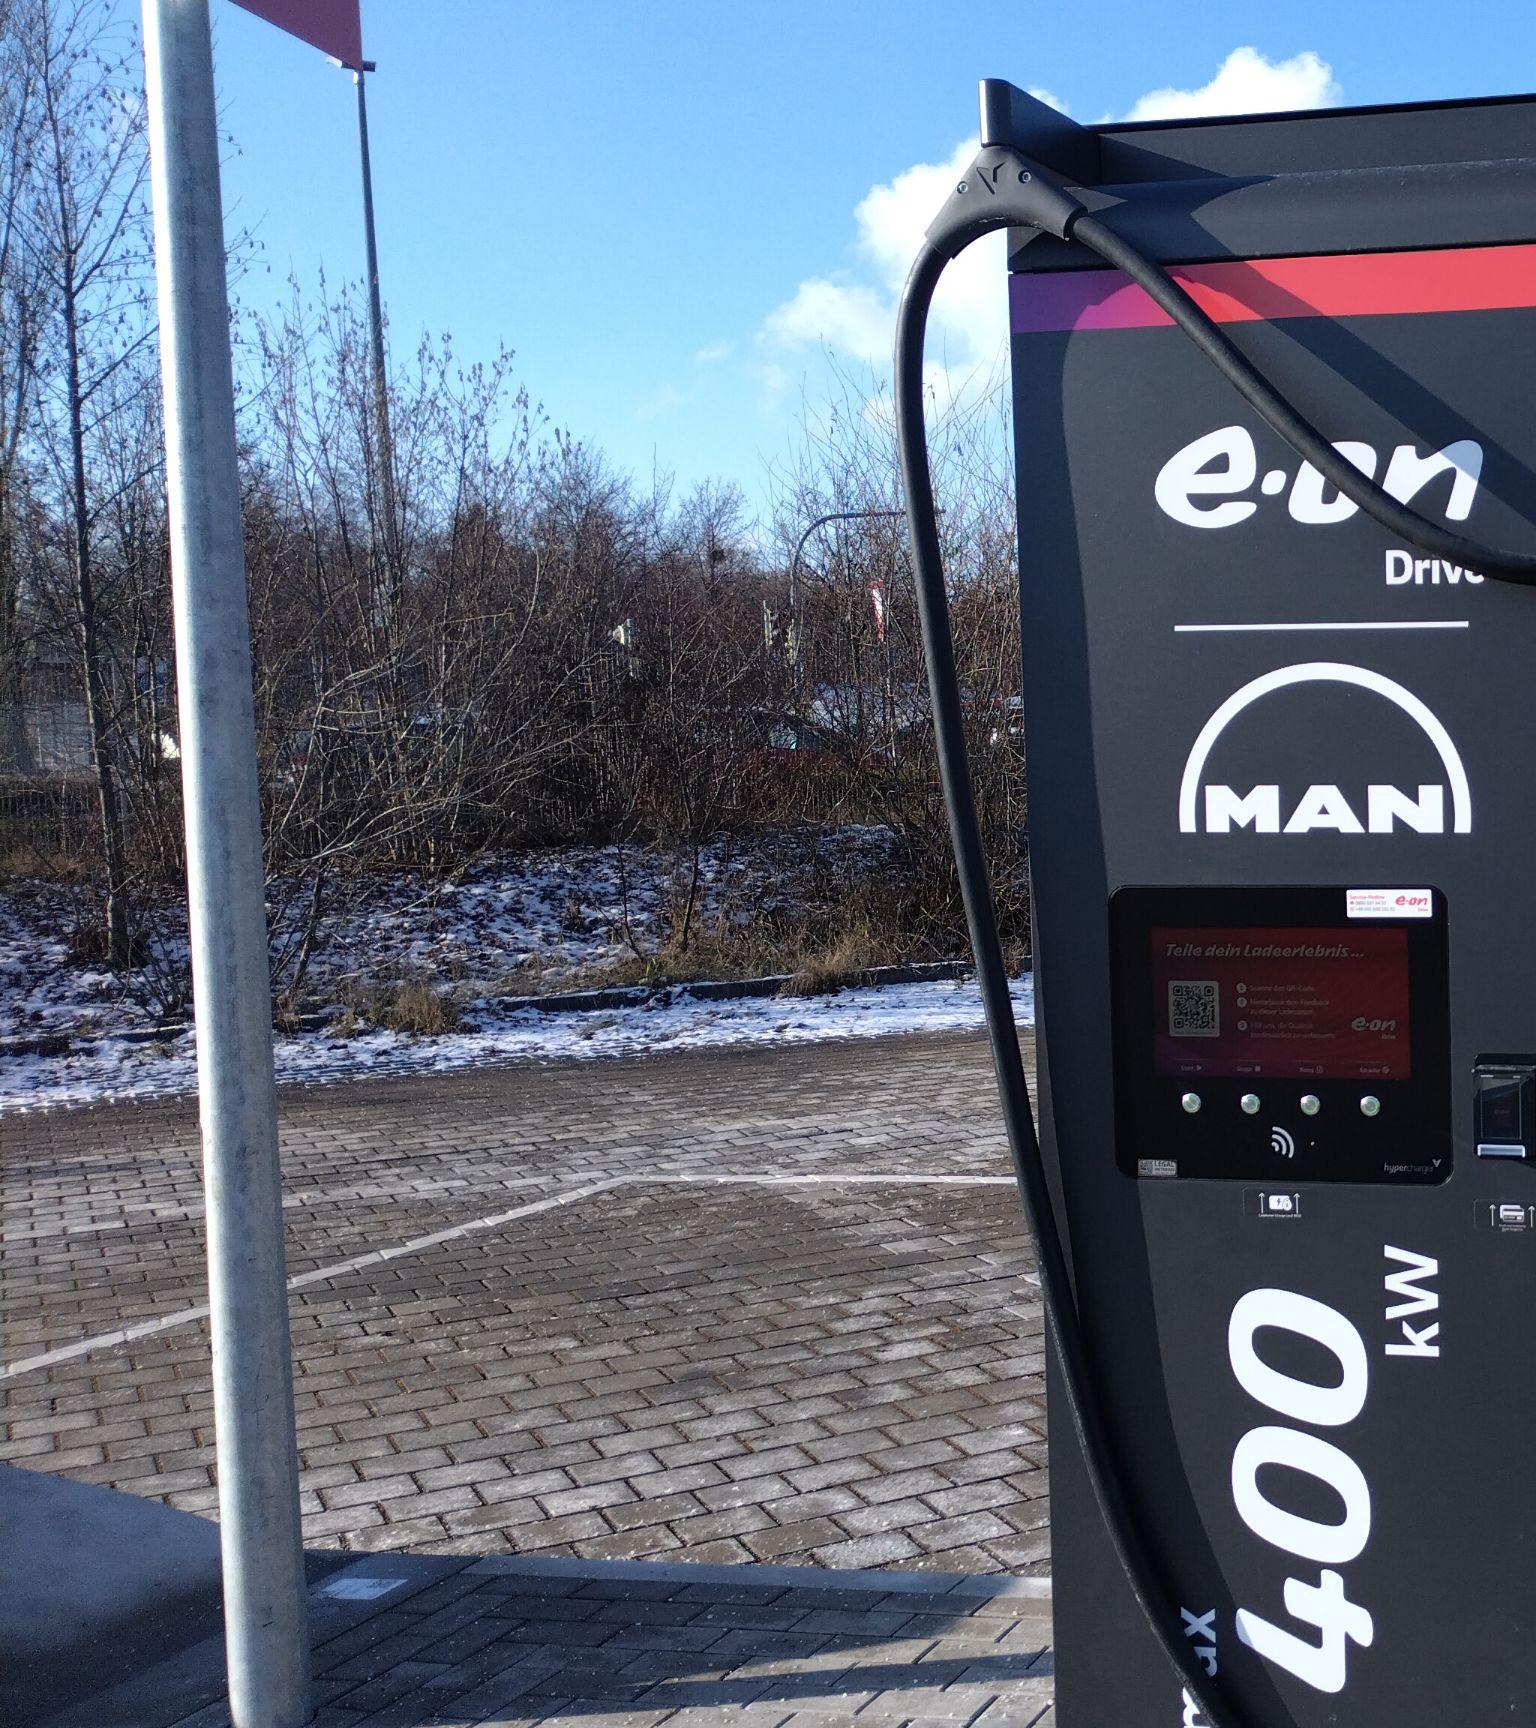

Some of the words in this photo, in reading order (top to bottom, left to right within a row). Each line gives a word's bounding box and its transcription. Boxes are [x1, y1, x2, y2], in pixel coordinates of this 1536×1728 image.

[1205, 785, 1443, 833] MAN
[1165, 943, 1202, 957] Teile
[1204, 943, 1241, 958] dein
[1384, 1245, 1440, 1357] kW
[1228, 1289, 1373, 1693] 400
